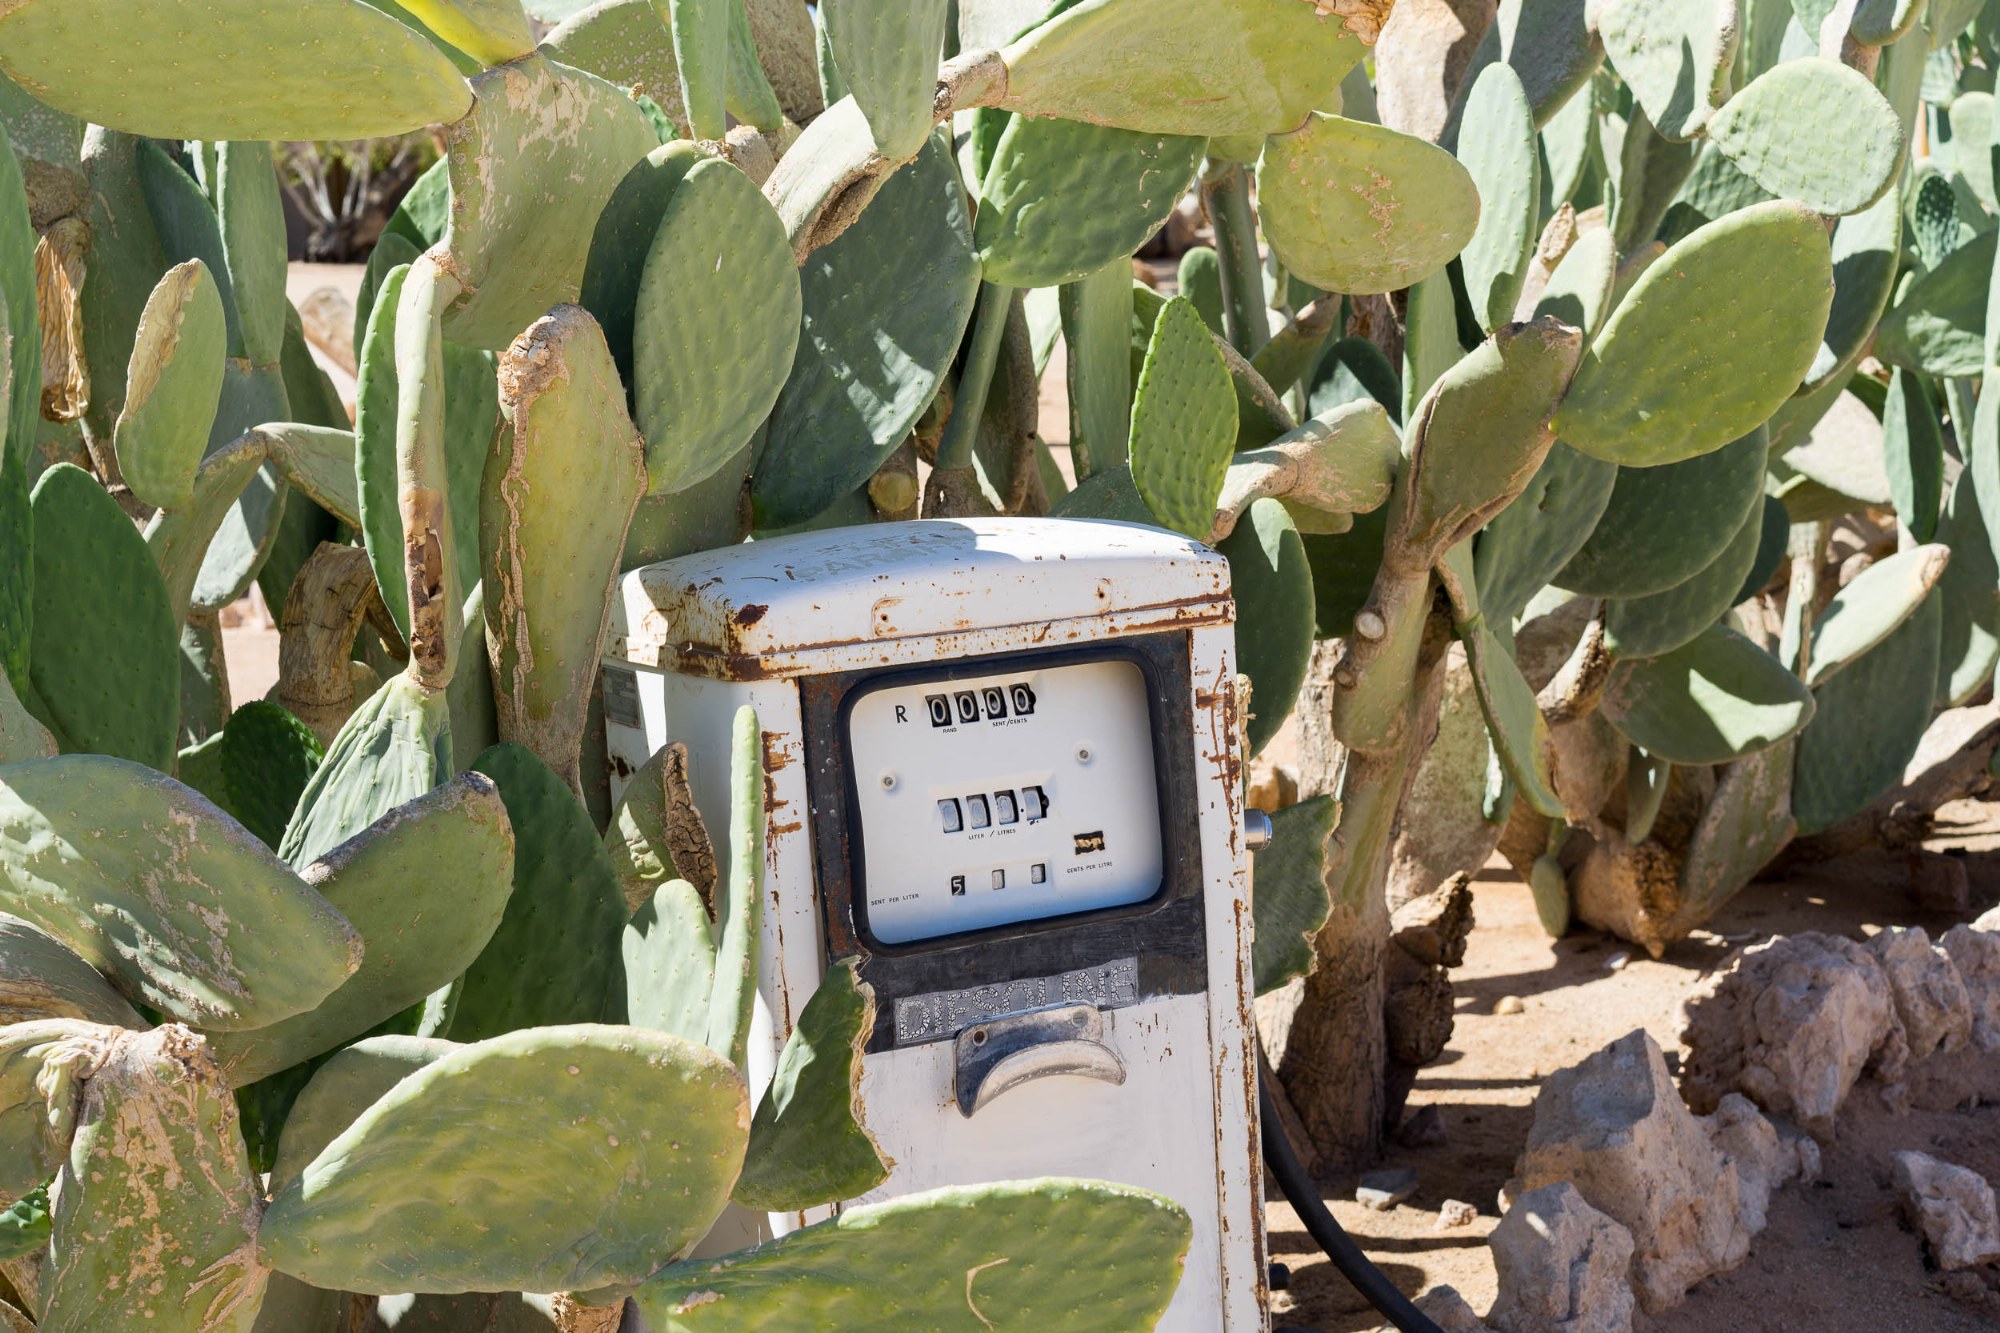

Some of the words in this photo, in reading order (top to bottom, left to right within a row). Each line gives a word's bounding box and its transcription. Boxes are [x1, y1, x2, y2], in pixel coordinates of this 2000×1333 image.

[895, 705, 908, 723] R
[1067, 866, 1084, 874] CENTS
[953, 879, 963, 896] 5
[871, 898, 885, 906] SENT
